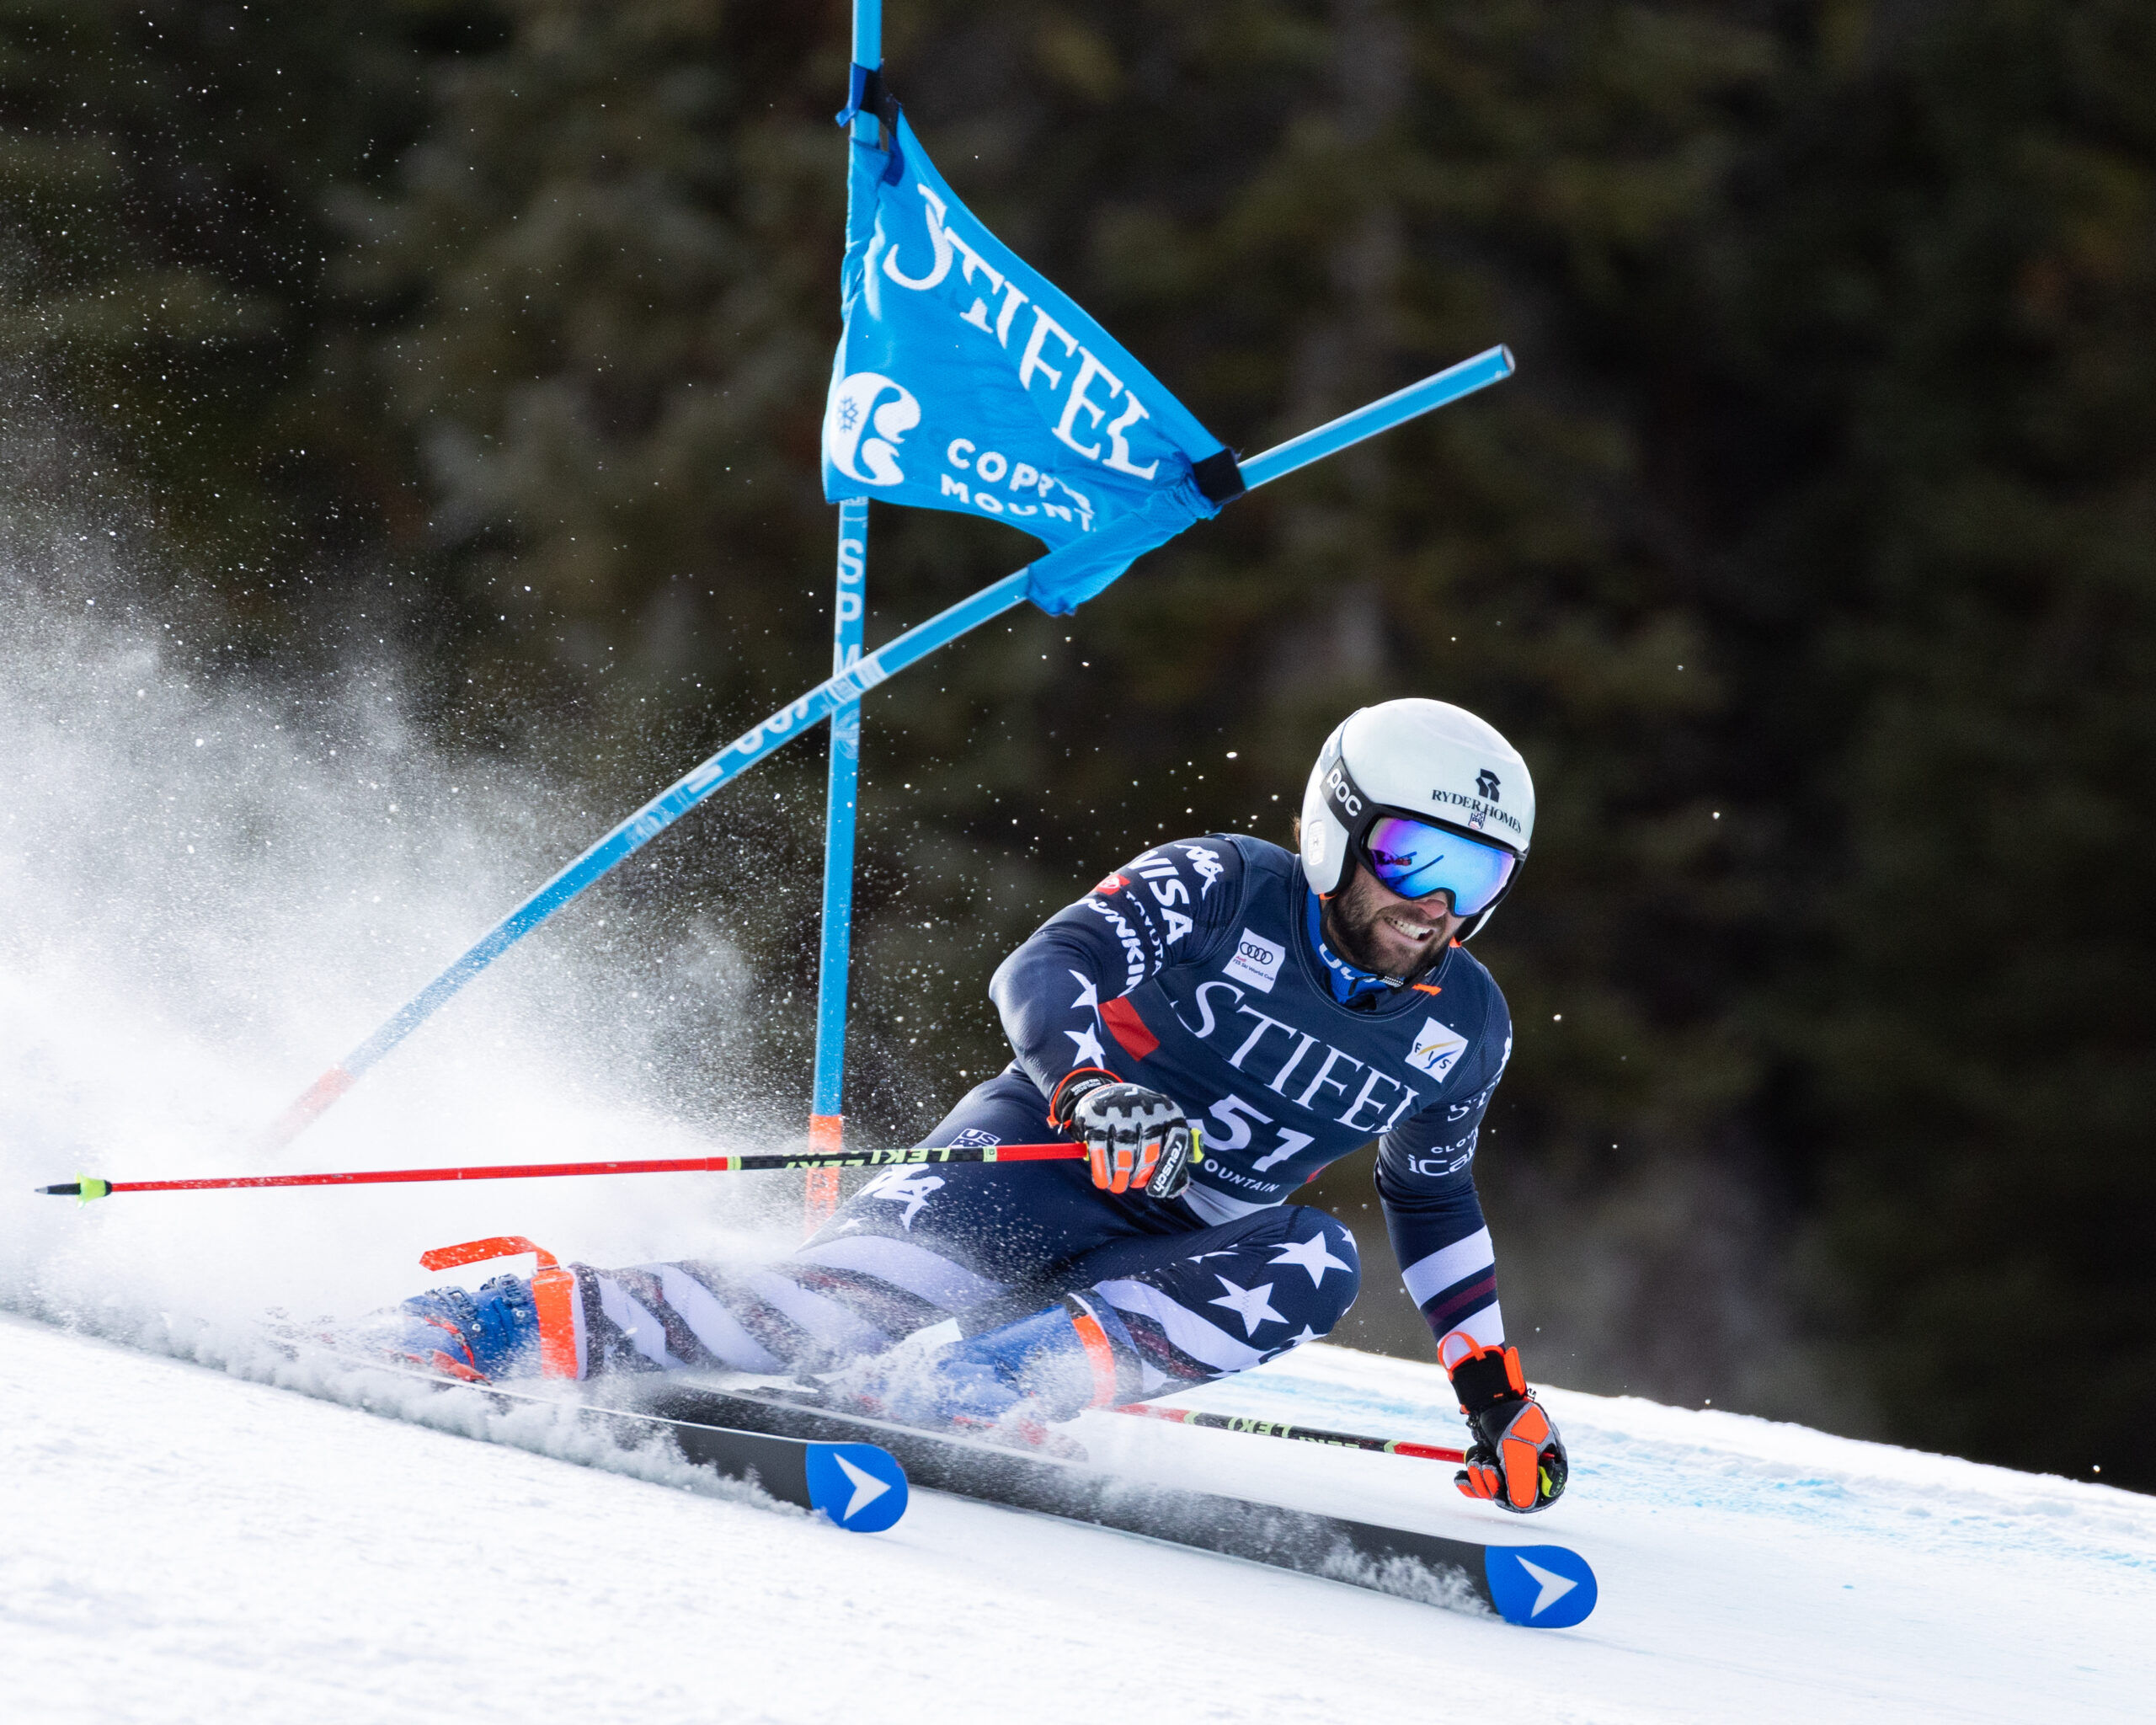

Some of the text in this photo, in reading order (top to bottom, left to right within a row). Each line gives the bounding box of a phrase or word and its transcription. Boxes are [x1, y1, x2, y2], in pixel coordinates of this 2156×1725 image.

[882, 183, 1159, 481] STIFEL
[1326, 767, 1362, 817] POC
[1431, 788, 1523, 835] RYDER HOMES
[1127, 850, 1193, 946] VISA
[1248, 966, 1264, 977] World
[1263, 974, 1274, 982] Cup
[1171, 980, 1421, 1135] STIFEL
[1414, 1042, 1451, 1071] FIS
[870, 1147, 951, 1166] LEKI
[961, 1128, 999, 1147] US
[1186, 1093, 1315, 1173] 51
[1153, 1140, 1183, 1193] reusch
[1204, 1150, 1281, 1193] OUNTAIN
[1227, 1416, 1294, 1439] LEKI
